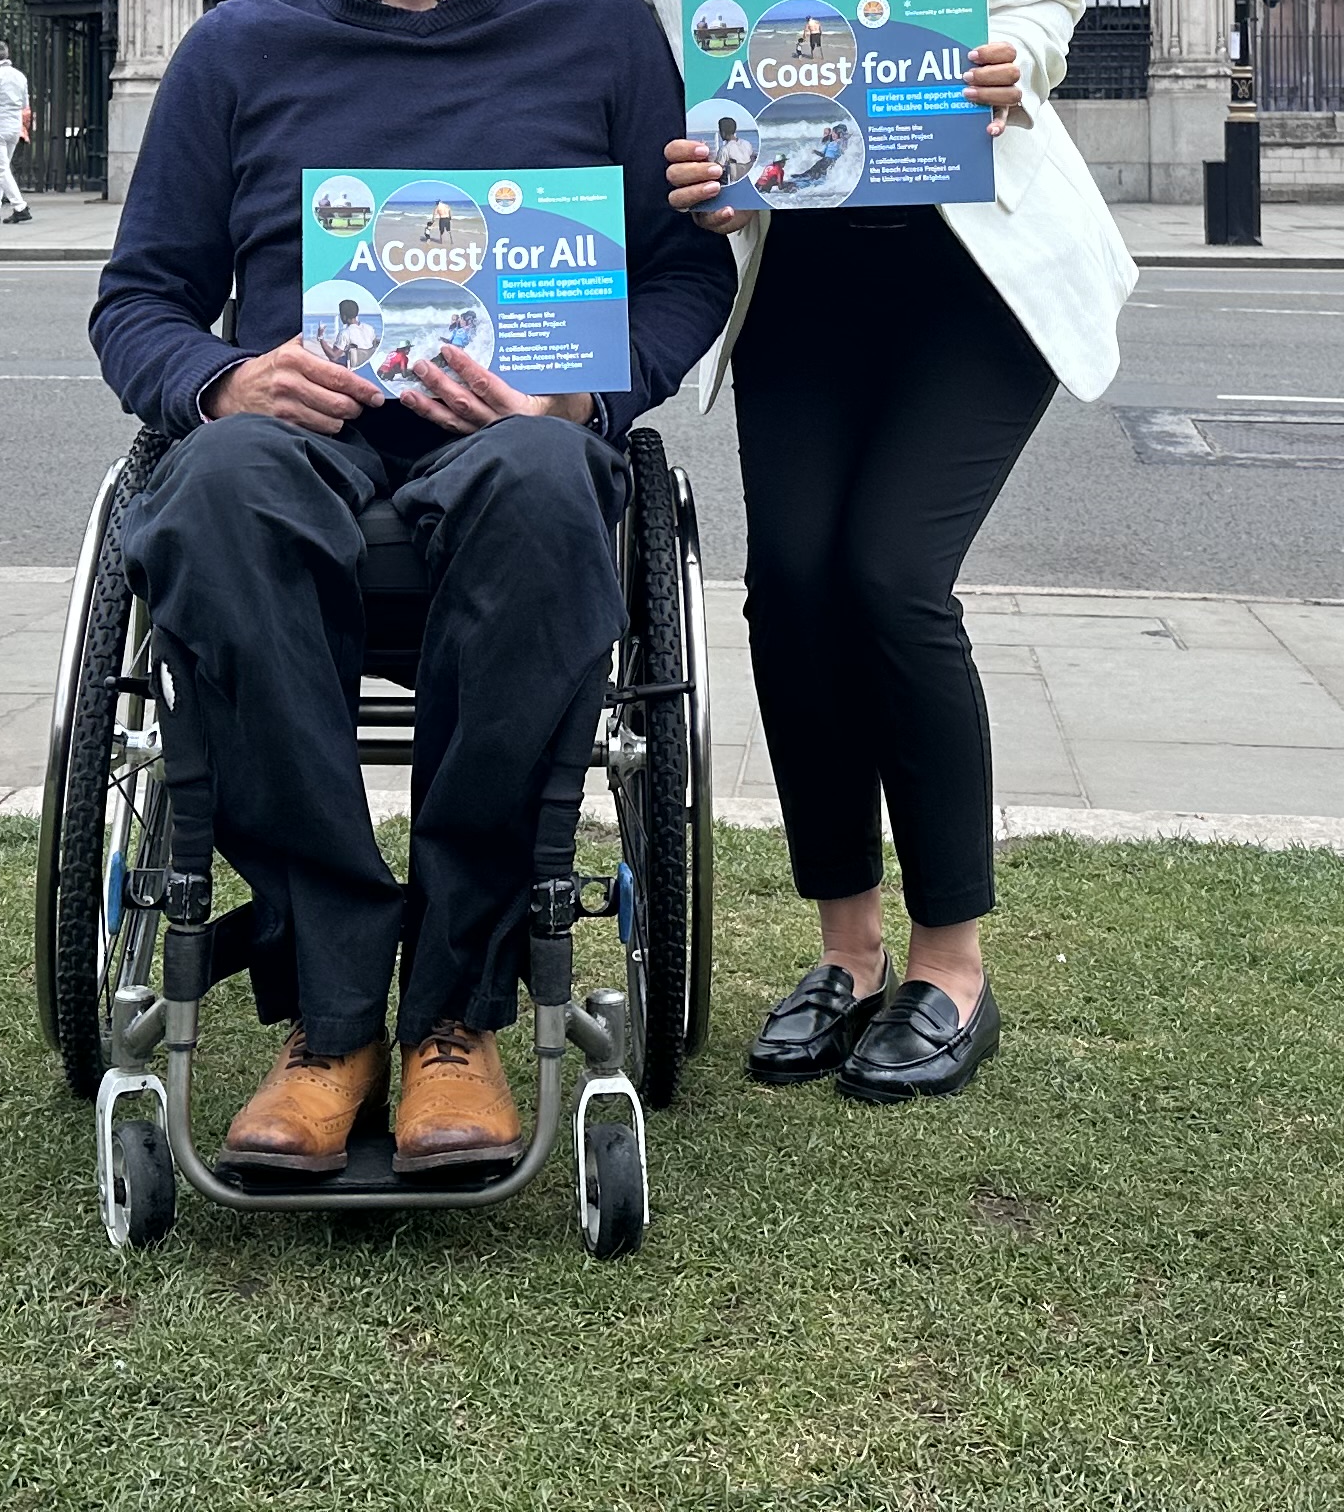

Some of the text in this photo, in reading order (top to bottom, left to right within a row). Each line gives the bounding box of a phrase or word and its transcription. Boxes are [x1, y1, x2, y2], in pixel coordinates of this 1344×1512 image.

[727, 48, 963, 89] A Coast for All
[872, 91, 963, 102] Barriers and opportun
[872, 104, 884, 112] for
[886, 102, 922, 111] inclusive
[924, 101, 949, 110] beach
[350, 235, 596, 271] A Coast for All
[502, 276, 613, 288] Barriers and opportunities
[502, 288, 612, 299] for inclusive beach access
[543, 320, 566, 328] Project
[549, 344, 569, 352] report
[571, 343, 579, 351] by
